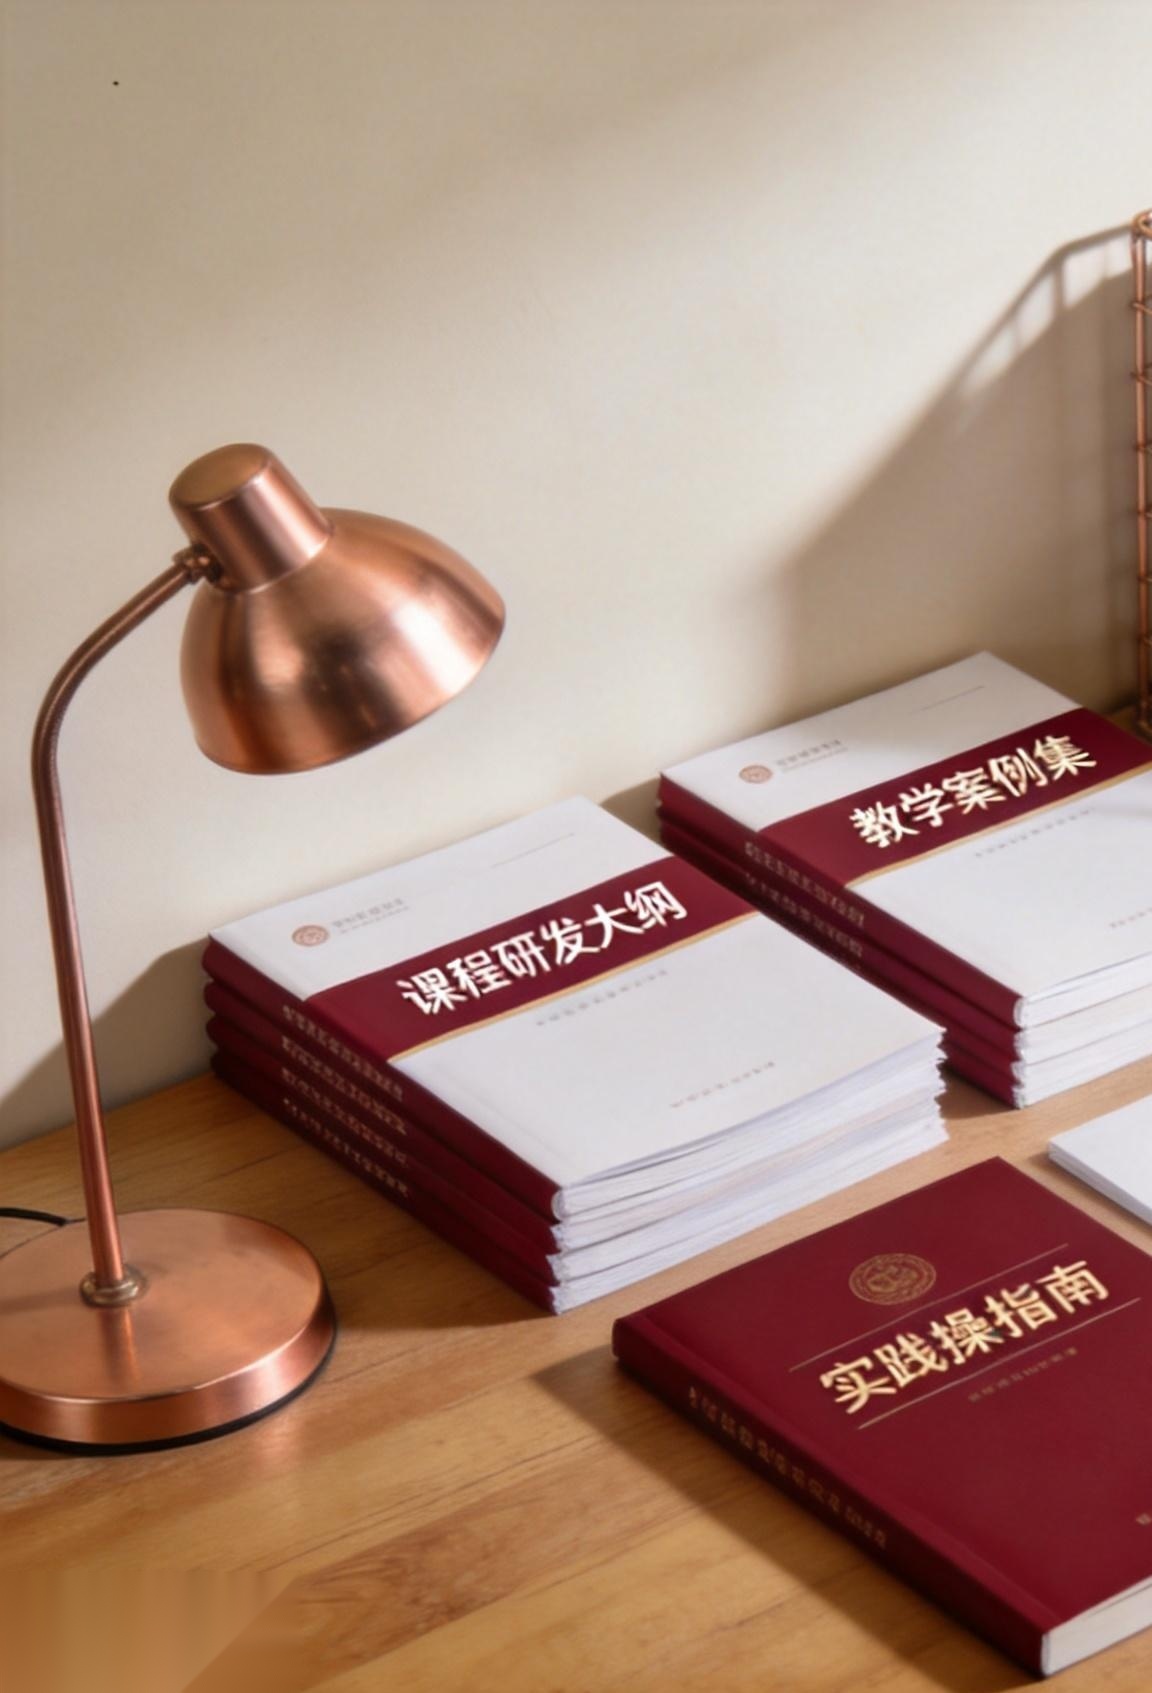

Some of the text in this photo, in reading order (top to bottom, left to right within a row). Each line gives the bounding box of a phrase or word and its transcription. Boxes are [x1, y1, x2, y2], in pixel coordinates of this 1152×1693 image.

[849, 735, 1097, 848] 教学案例集
[396, 881, 687, 1015] 课程研发大纲
[820, 1260, 1109, 1414] 实践操指南
